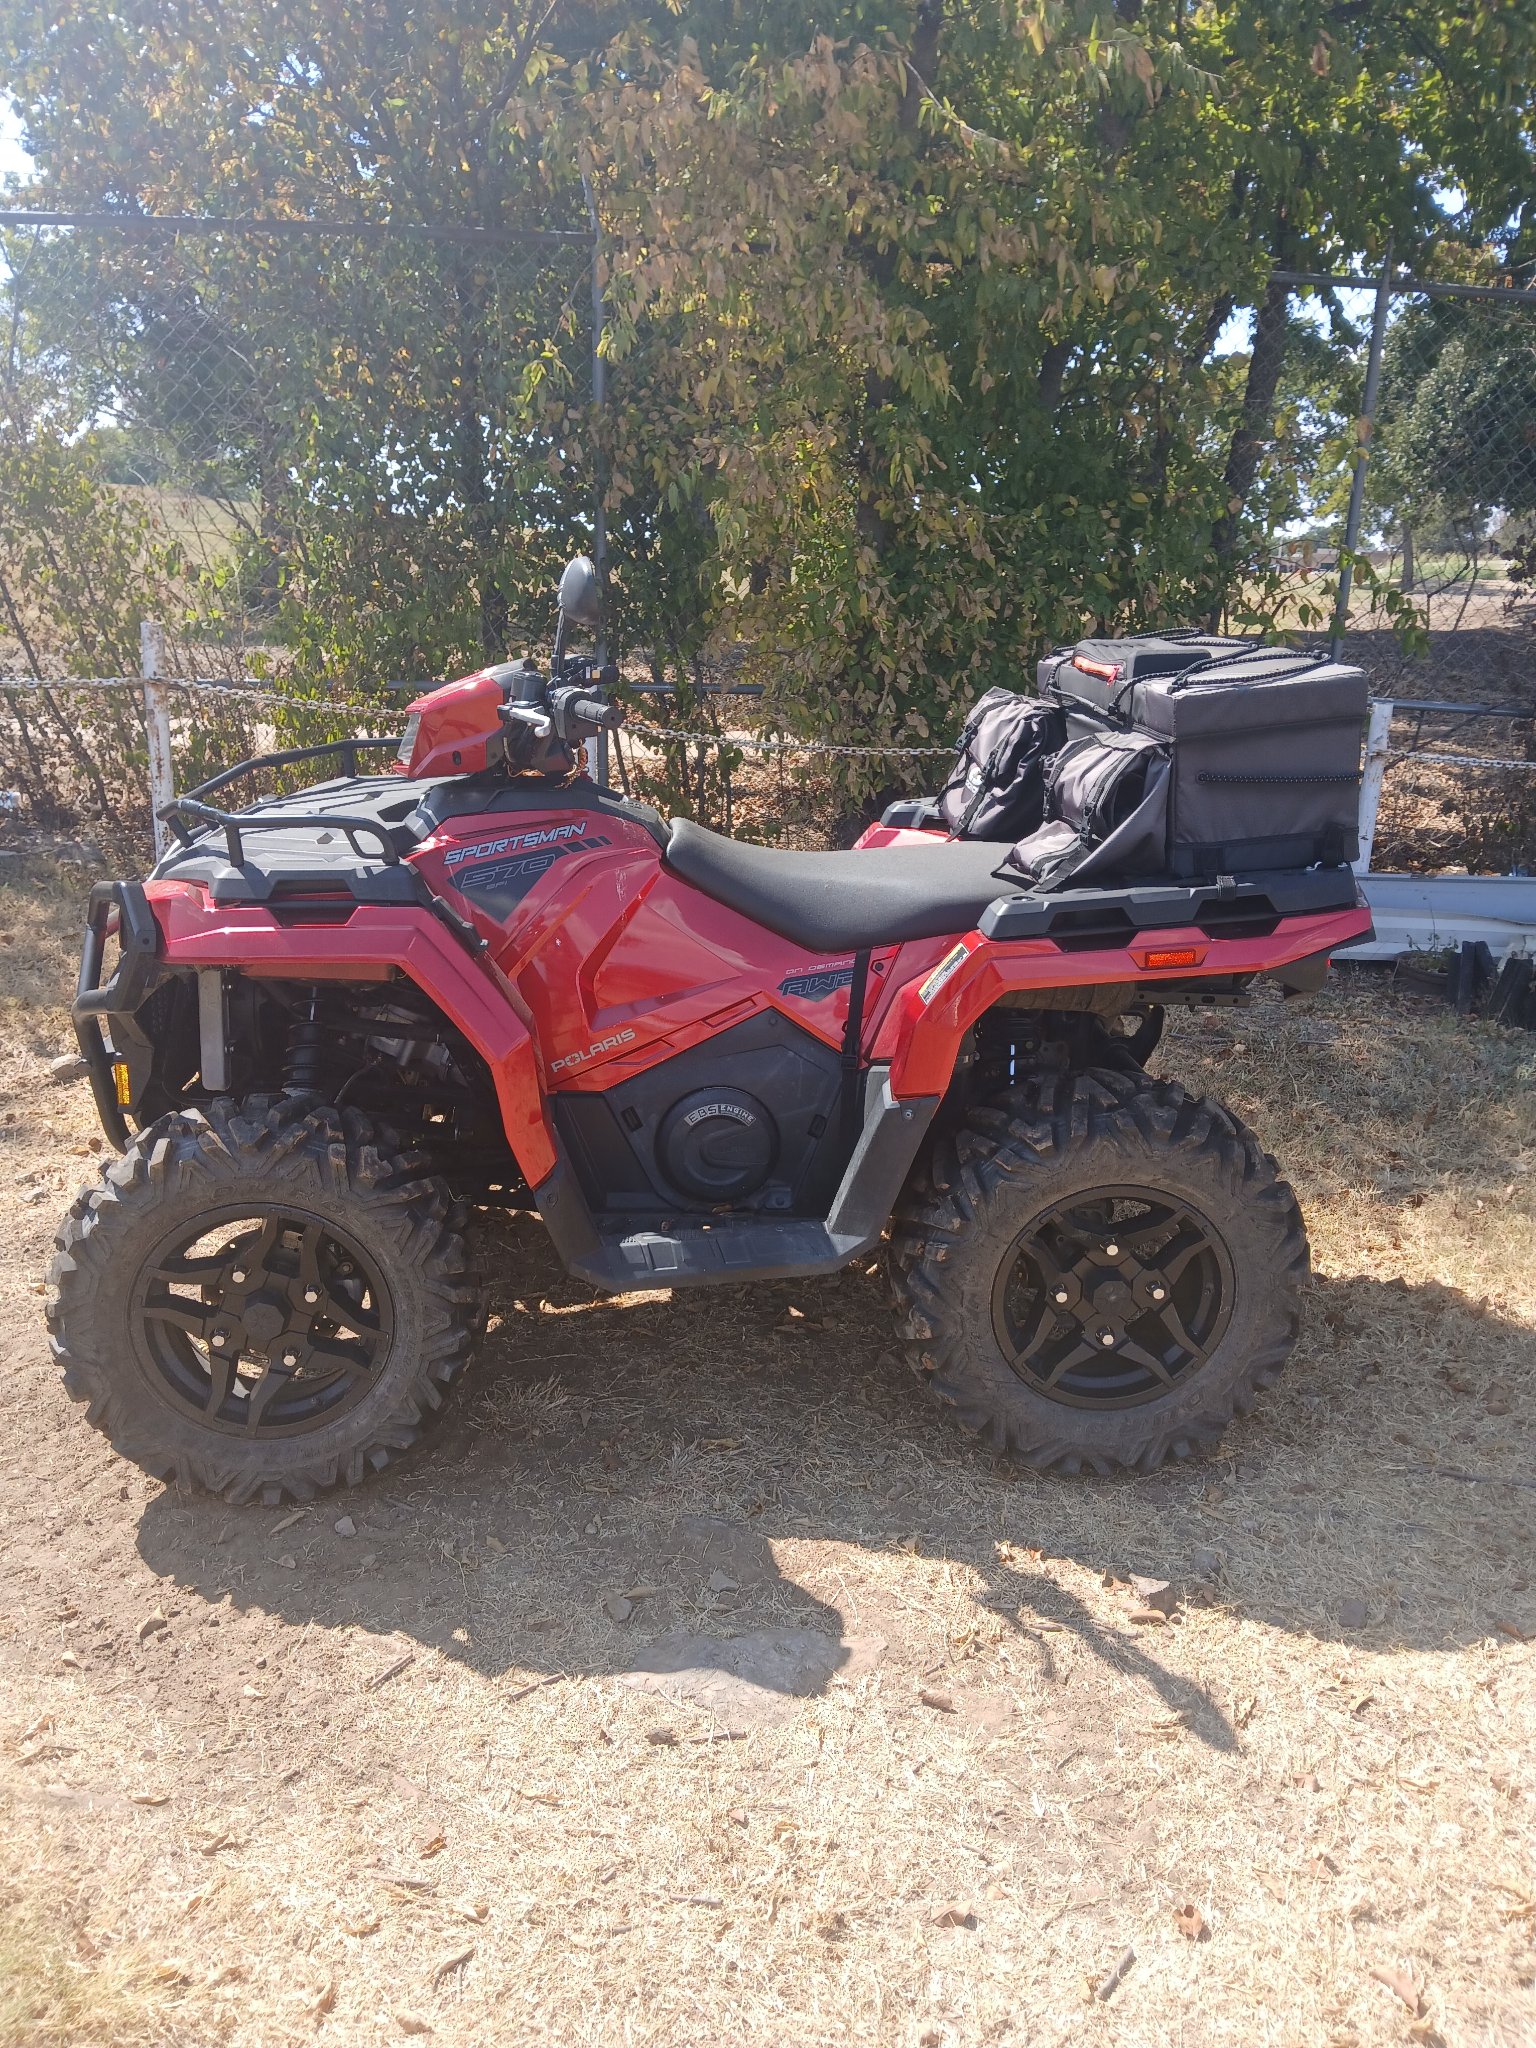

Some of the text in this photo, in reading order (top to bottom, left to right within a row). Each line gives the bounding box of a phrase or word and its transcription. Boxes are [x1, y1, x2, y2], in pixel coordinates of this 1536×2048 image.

[443, 821, 587, 865] SPORTSMAN
[461, 854, 556, 889] 570
[785, 967, 804, 975] ON
[550, 1028, 636, 1073] POLARIS
[688, 1105, 717, 1123] EBS
[720, 1105, 755, 1122] ENGINE
